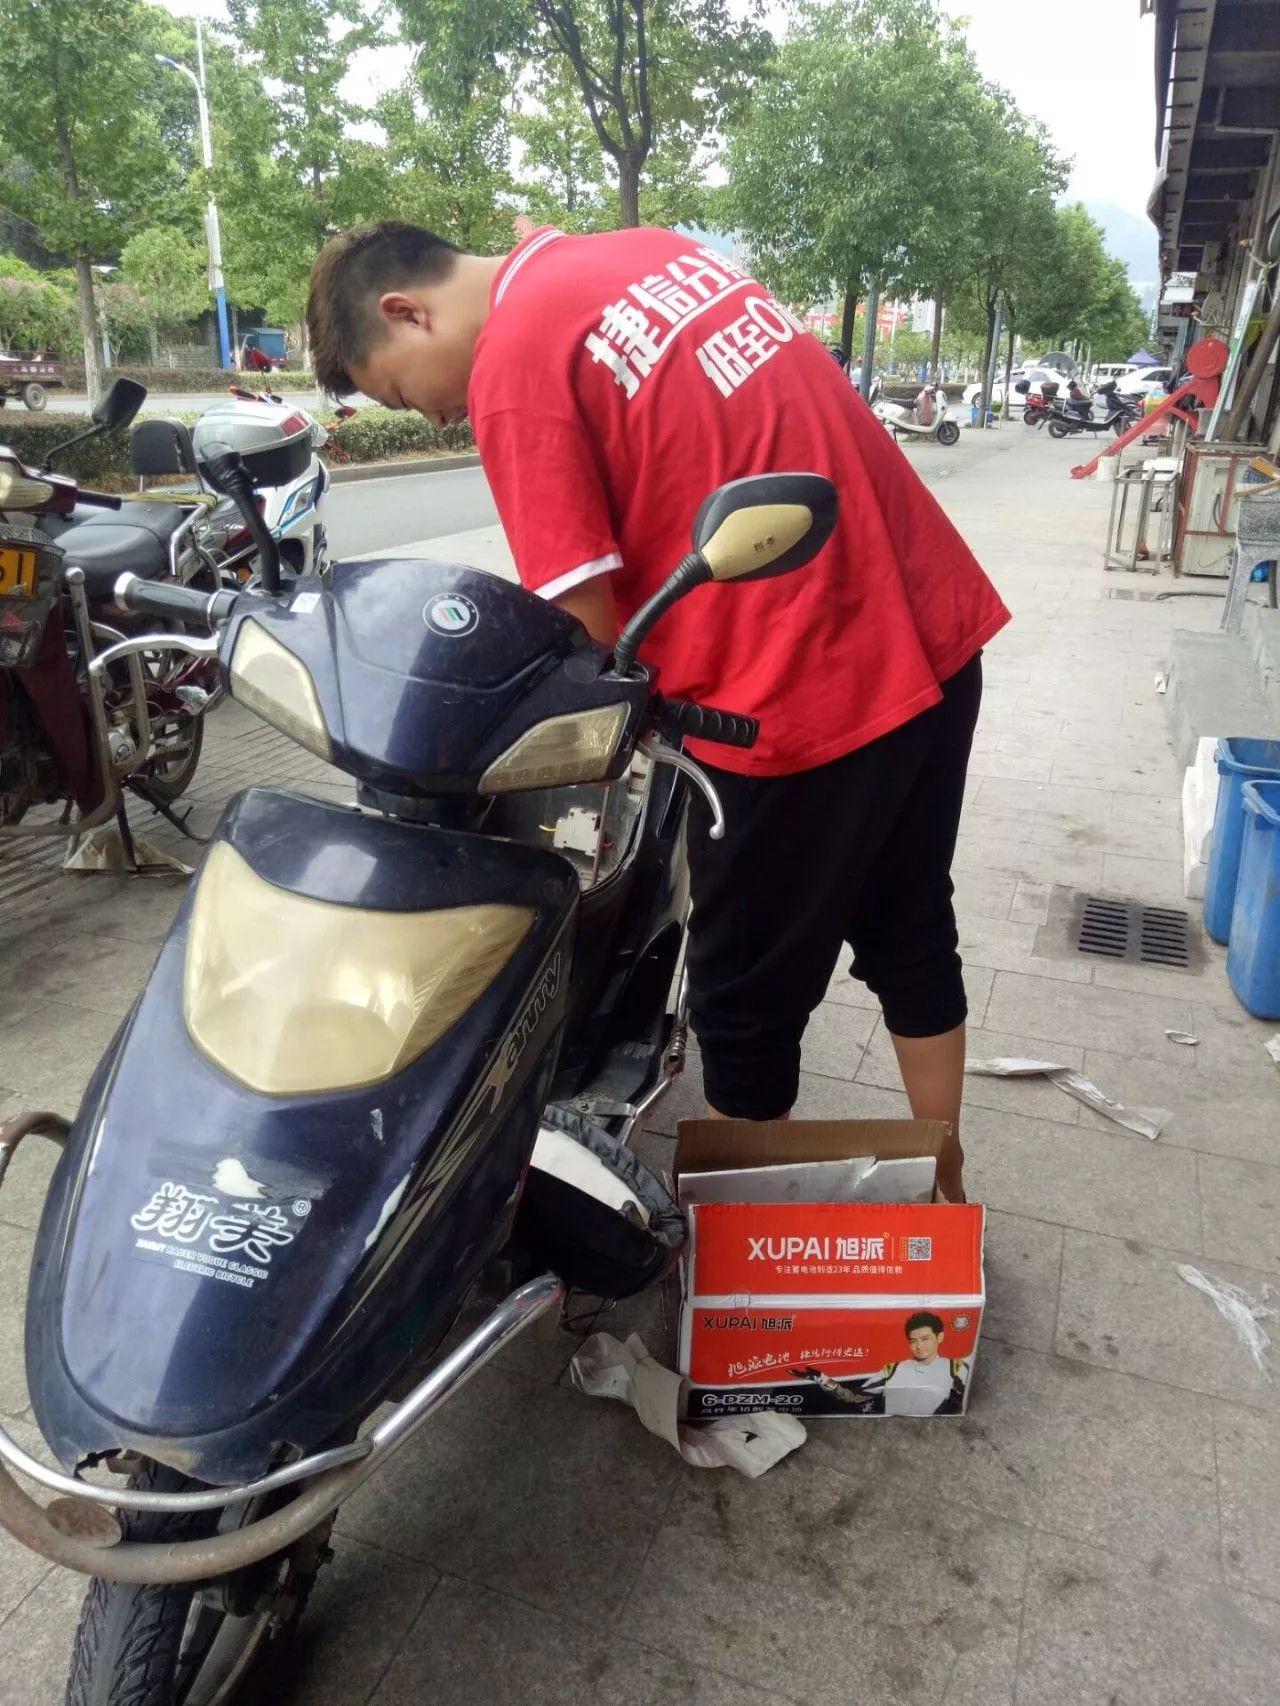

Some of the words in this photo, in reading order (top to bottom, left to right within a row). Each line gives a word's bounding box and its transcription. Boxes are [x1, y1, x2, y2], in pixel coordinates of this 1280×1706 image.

[0, 552, 24, 584] 1
[747, 1237, 829, 1260] XUPAI
[835, 1236, 884, 1260] 旭派
[704, 1316, 757, 1330] XUPAI
[761, 1317, 793, 1330] 旭派
